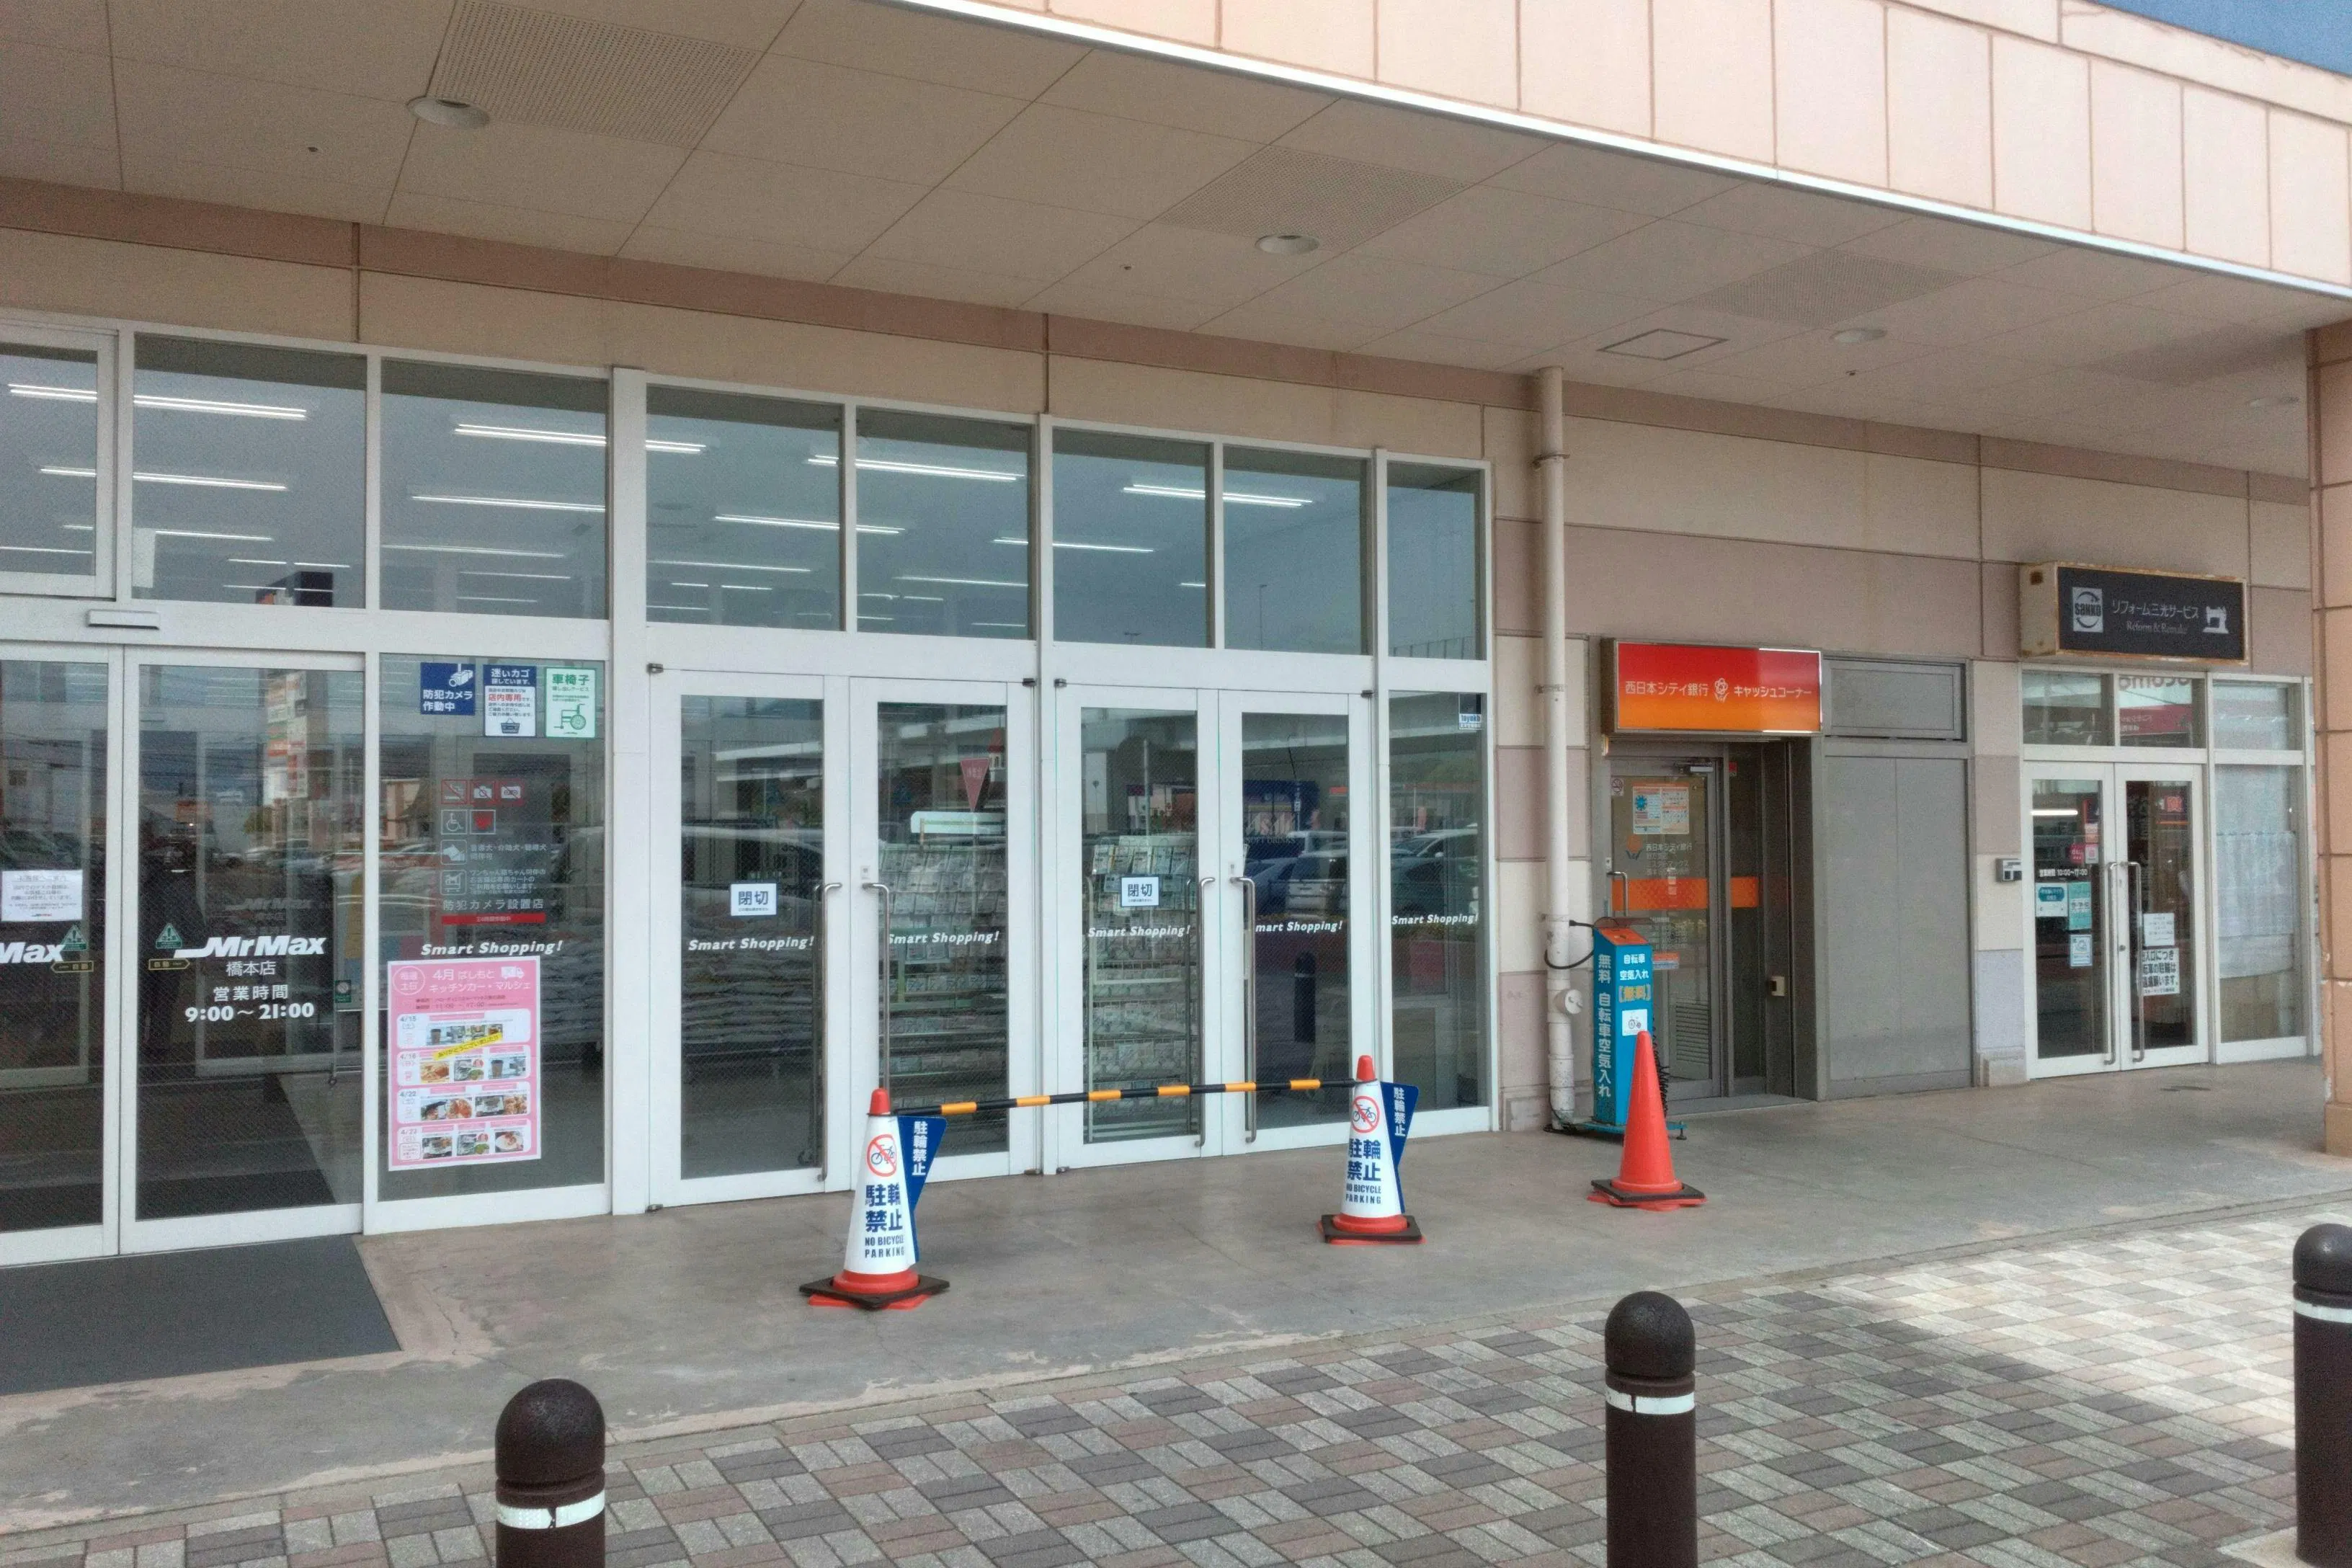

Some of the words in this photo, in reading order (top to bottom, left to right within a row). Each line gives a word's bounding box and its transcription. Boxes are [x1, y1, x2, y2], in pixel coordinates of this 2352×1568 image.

[552, 674, 589, 686] 車椅子
[423, 689, 473, 700] 防犯カメラ
[1625, 680, 1709, 697] 西日本シティ銀行
[1734, 685, 1812, 698] キャッシュコーナー
[423, 701, 455, 712] 作動中
[1128, 883, 1153, 897] 閉切
[443, 899, 544, 912] 防犯カメラ設置店
[738, 891, 769, 906] 閉切
[1391, 914, 1424, 925] Smart
[1427, 913, 1479, 925] Shopping!
[1088, 927, 1126, 937] Smart
[1130, 925, 1190, 938] Shopping!
[1255, 922, 1283, 932] mart
[1287, 920, 1342, 934] Shopping!
[688, 939, 736, 951] Smart
[739, 936, 815, 951] Shopping!
[932, 931, 999, 945] Shopping!
[173, 935, 326, 958] MrMax
[421, 944, 473, 956] Smart
[478, 940, 564, 956] Shopping!
[1623, 953, 1646, 965] 自転車
[226, 961, 277, 976] 橋本店
[432, 968, 454, 981] 4月
[1598, 953, 1612, 984] 無料
[1619, 968, 1649, 981] 空気入れ
[213, 984, 288, 1002] 営業時間
[1598, 992, 1612, 1097] 自転車空気入れ
[1393, 1087, 1407, 1137] 駐輪禁止
[911, 1121, 929, 1177] 駐輪禁止
[1348, 1138, 1381, 1160] 駐輪
[1346, 1161, 1381, 1182] 禁止
[865, 1182, 901, 1207] 駐輪
[1353, 1184, 1381, 1194] BICYCLE
[1345, 1193, 1381, 1204] PARKING
[865, 1209, 903, 1233] 禁止
[865, 1237, 876, 1246] NO
[878, 1236, 904, 1246] BICYCLE
[865, 1247, 904, 1258] PARKING
